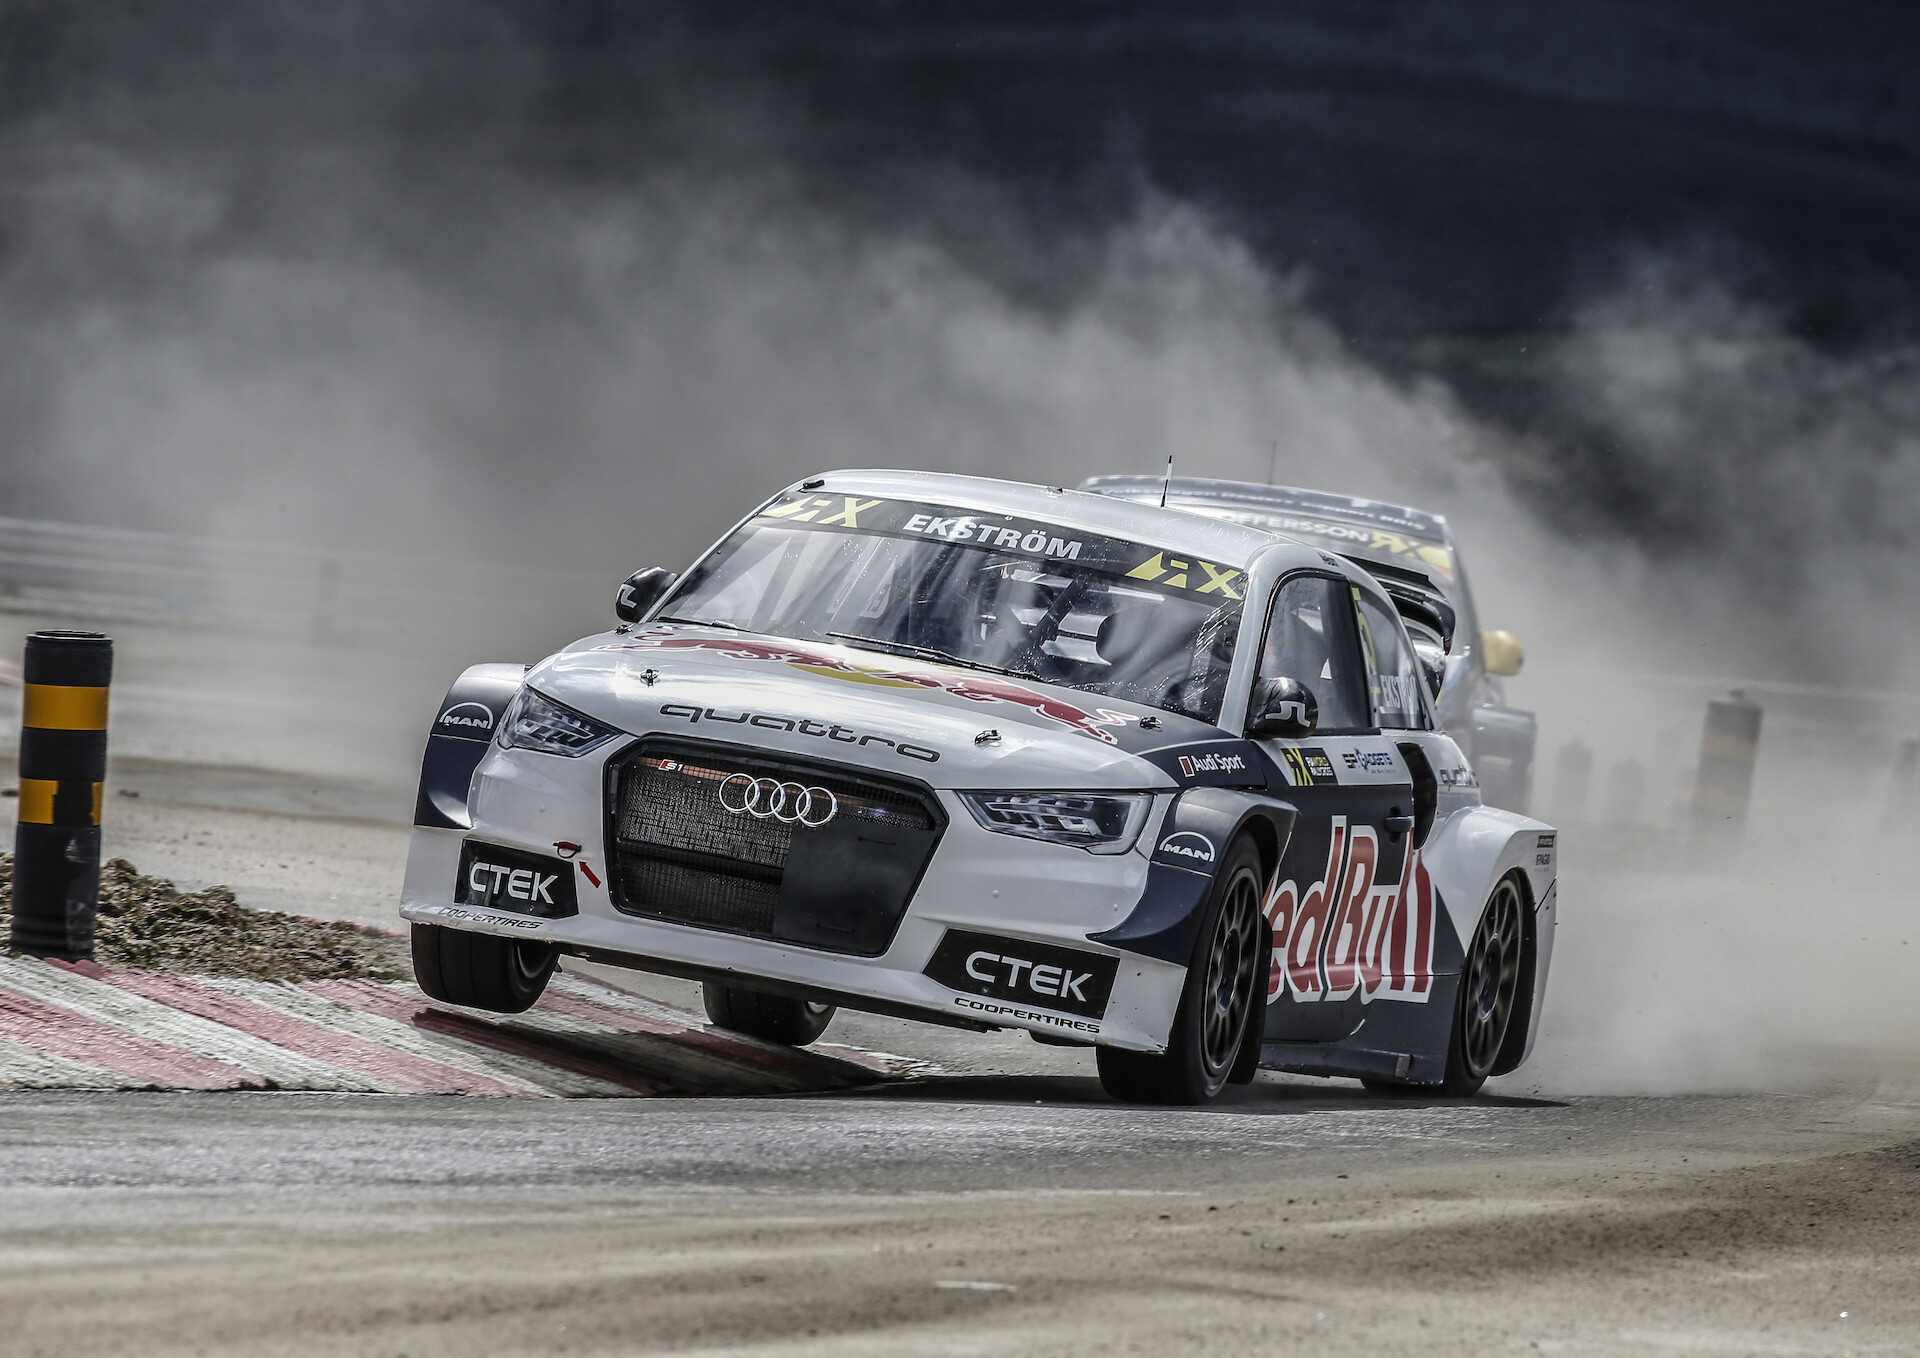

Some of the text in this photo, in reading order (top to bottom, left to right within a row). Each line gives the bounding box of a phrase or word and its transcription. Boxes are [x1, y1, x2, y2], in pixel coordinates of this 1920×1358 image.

[902, 513, 1083, 561] EKSTRÖM
[659, 703, 940, 763] quattro
[1191, 752, 1246, 774] Audi Sport
[1163, 843, 1211, 861] MAN
[469, 861, 559, 905] CTEK
[1262, 815, 1347, 1005] ed
[965, 950, 1094, 1003] CTEK
[953, 996, 1100, 1034] COOPERTIRES
